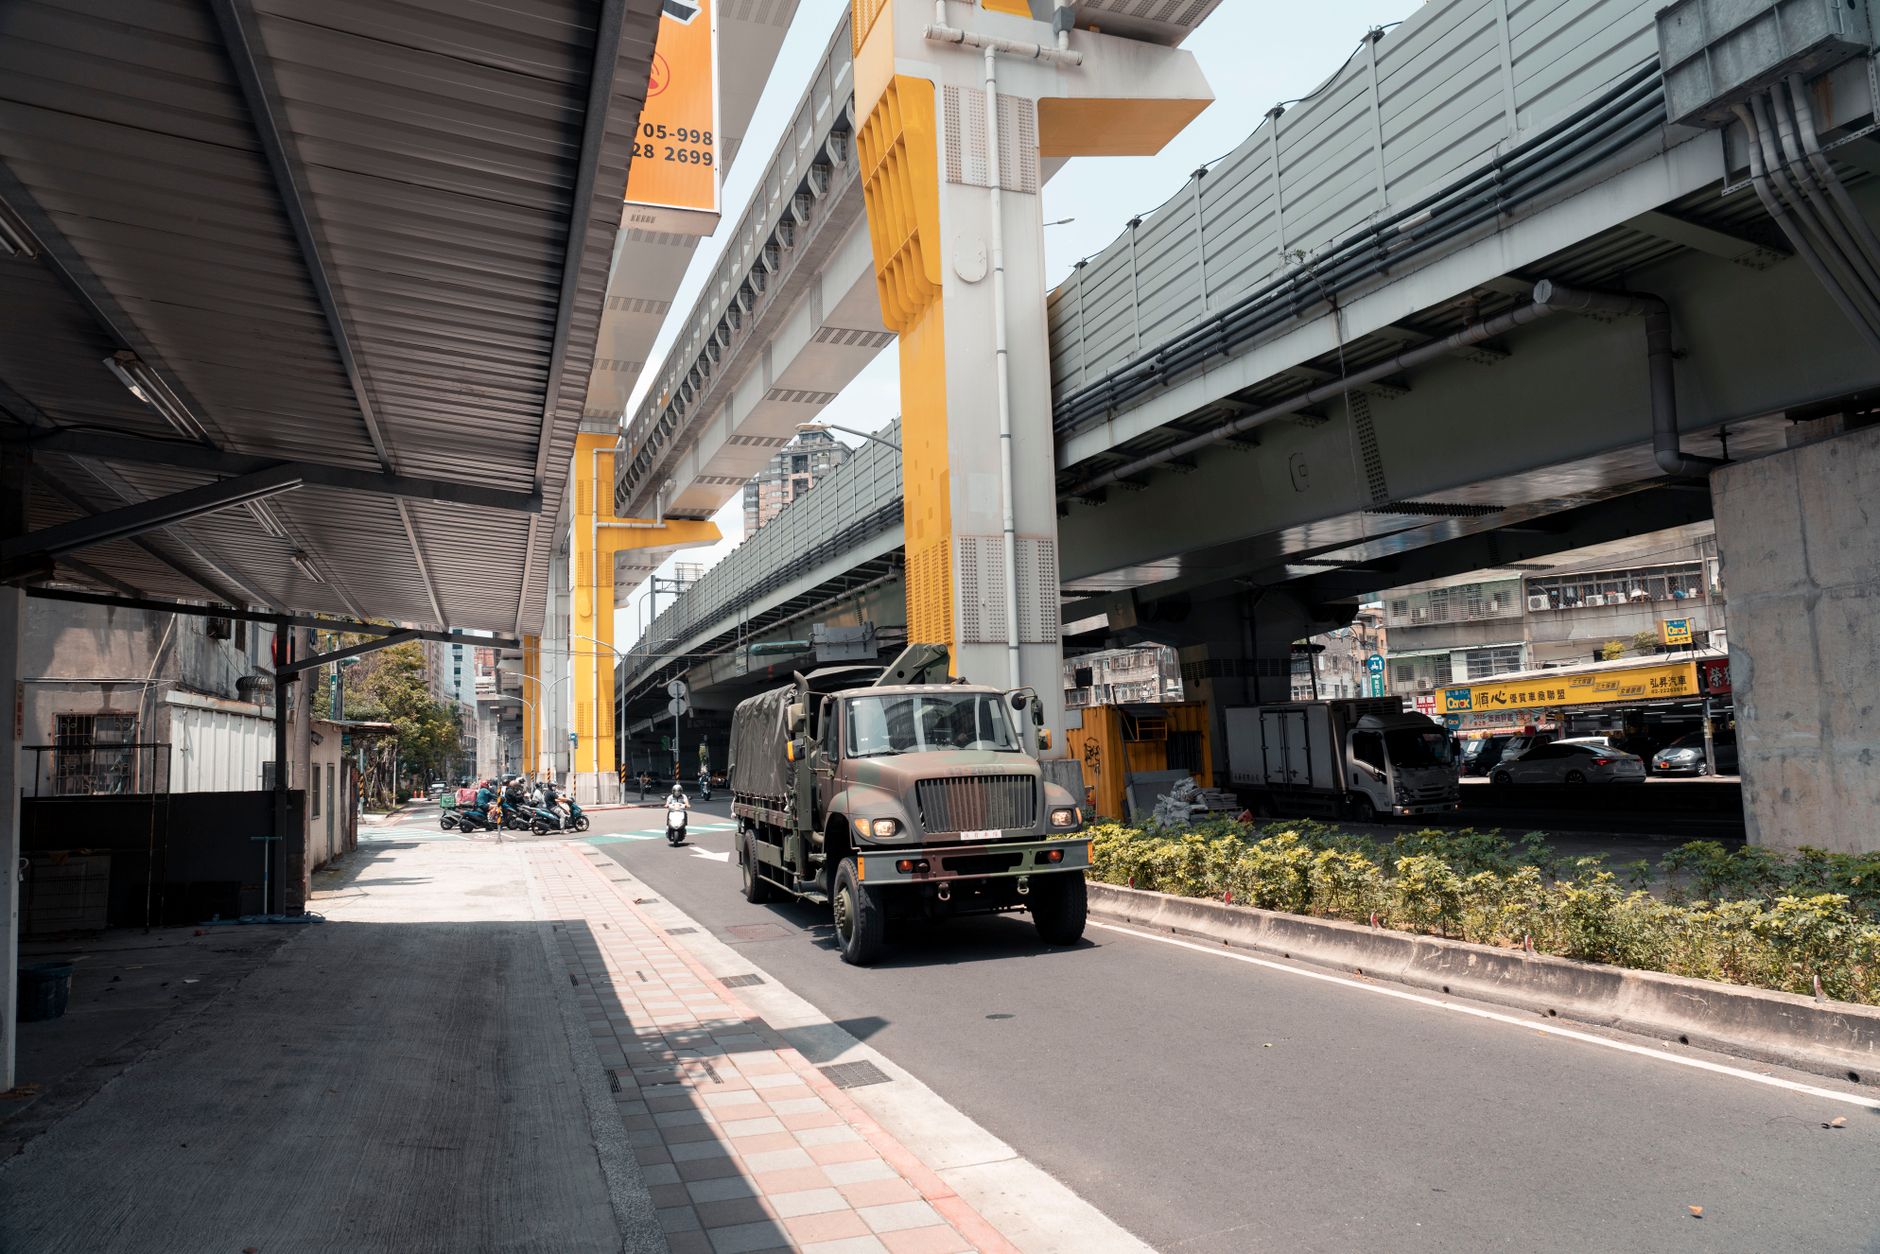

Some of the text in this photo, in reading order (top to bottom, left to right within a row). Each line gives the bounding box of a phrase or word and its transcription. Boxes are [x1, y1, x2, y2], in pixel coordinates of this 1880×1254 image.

[638, 123, 713, 146] 05-998
[664, 146, 713, 167] 2699
[1650, 675, 1687, 689] 弘昇汽車
[1509, 689, 1566, 704] 優質車商聯盟
